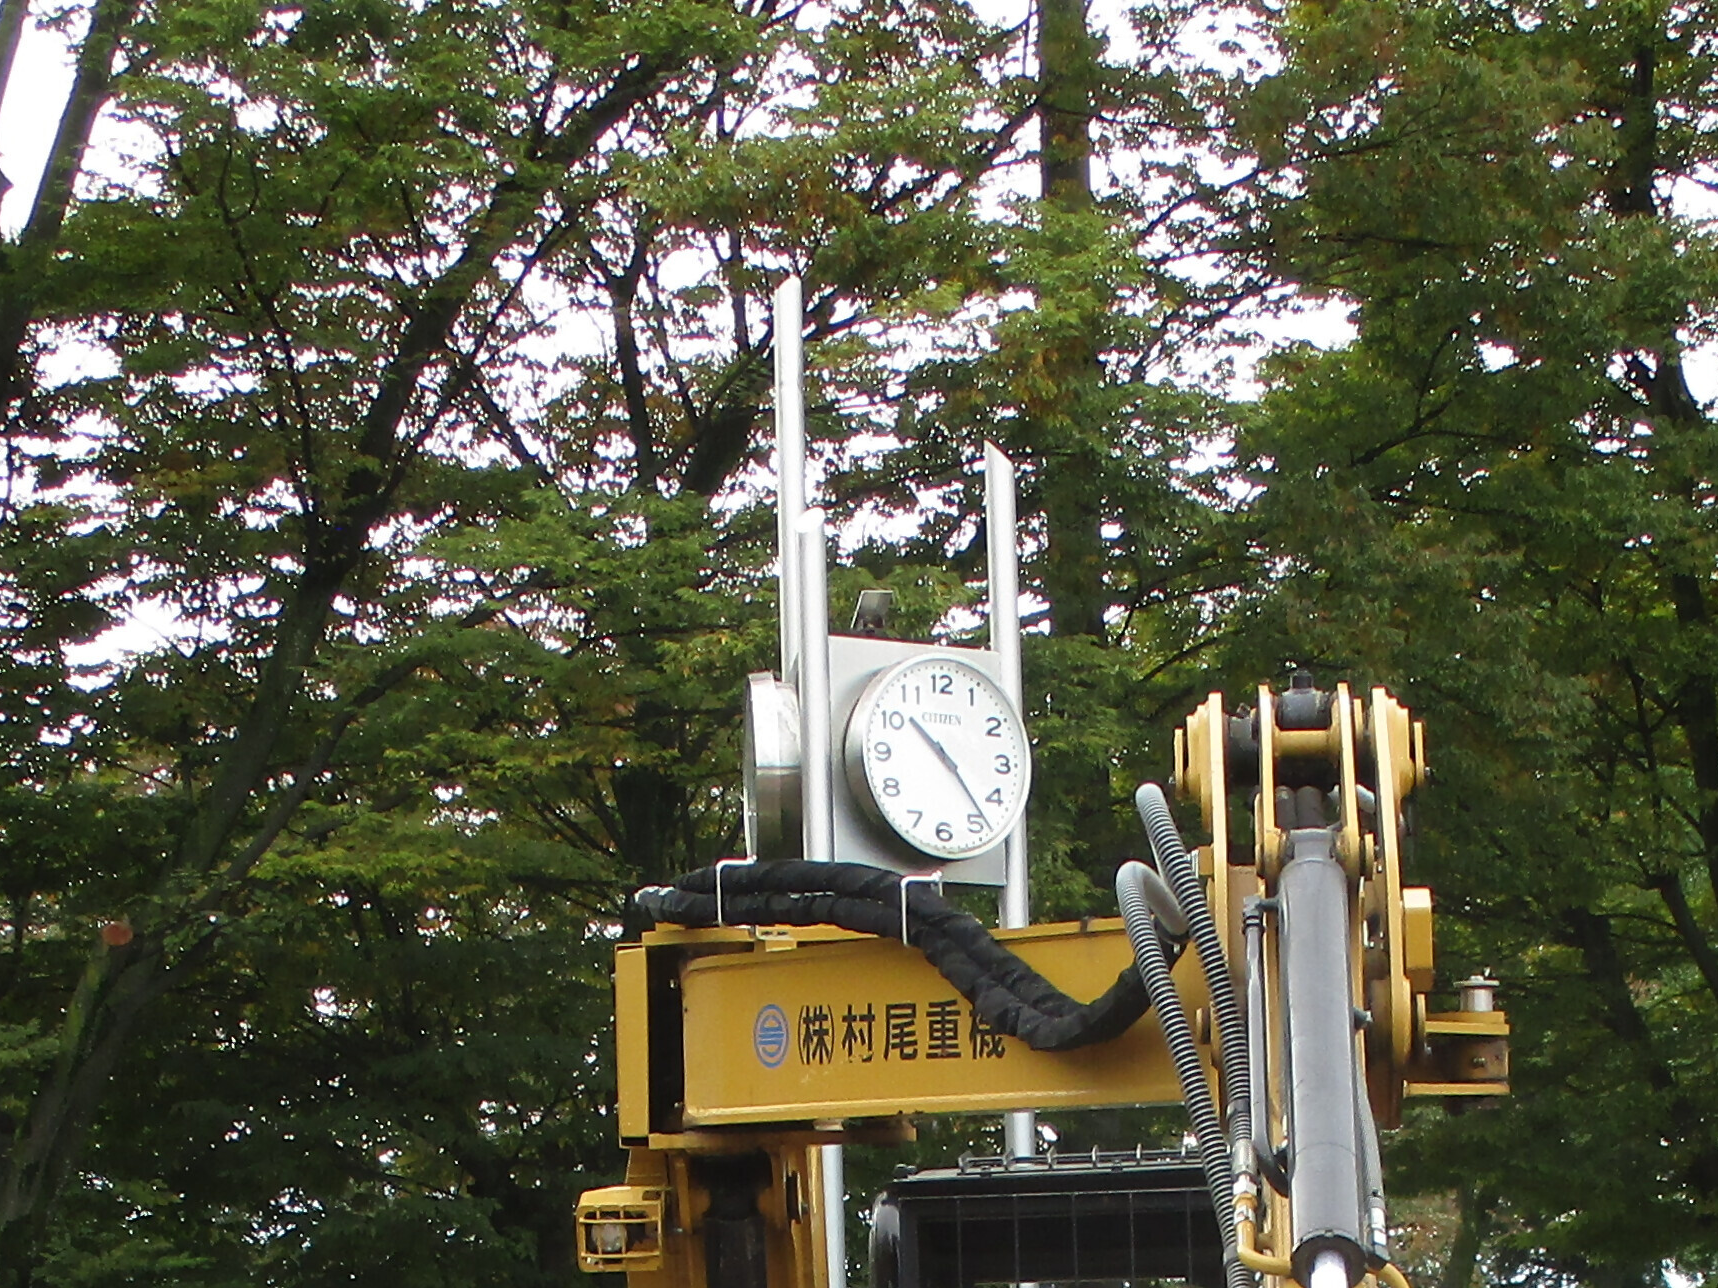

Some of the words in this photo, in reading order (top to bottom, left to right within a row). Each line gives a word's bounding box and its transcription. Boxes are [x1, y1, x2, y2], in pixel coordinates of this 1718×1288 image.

[931, 673, 953, 695] 12
[901, 684, 920, 705] 11
[968, 687, 974, 707] 1
[881, 710, 905, 730] 10
[922, 711, 962, 726] CITIZEN
[985, 717, 1002, 737] 2
[874, 741, 892, 762] 9
[994, 754, 1011, 775] 3
[882, 777, 901, 797] 8
[985, 788, 1003, 807] 4
[907, 809, 923, 829] 7
[967, 813, 984, 834] 5
[935, 822, 953, 842] 6
